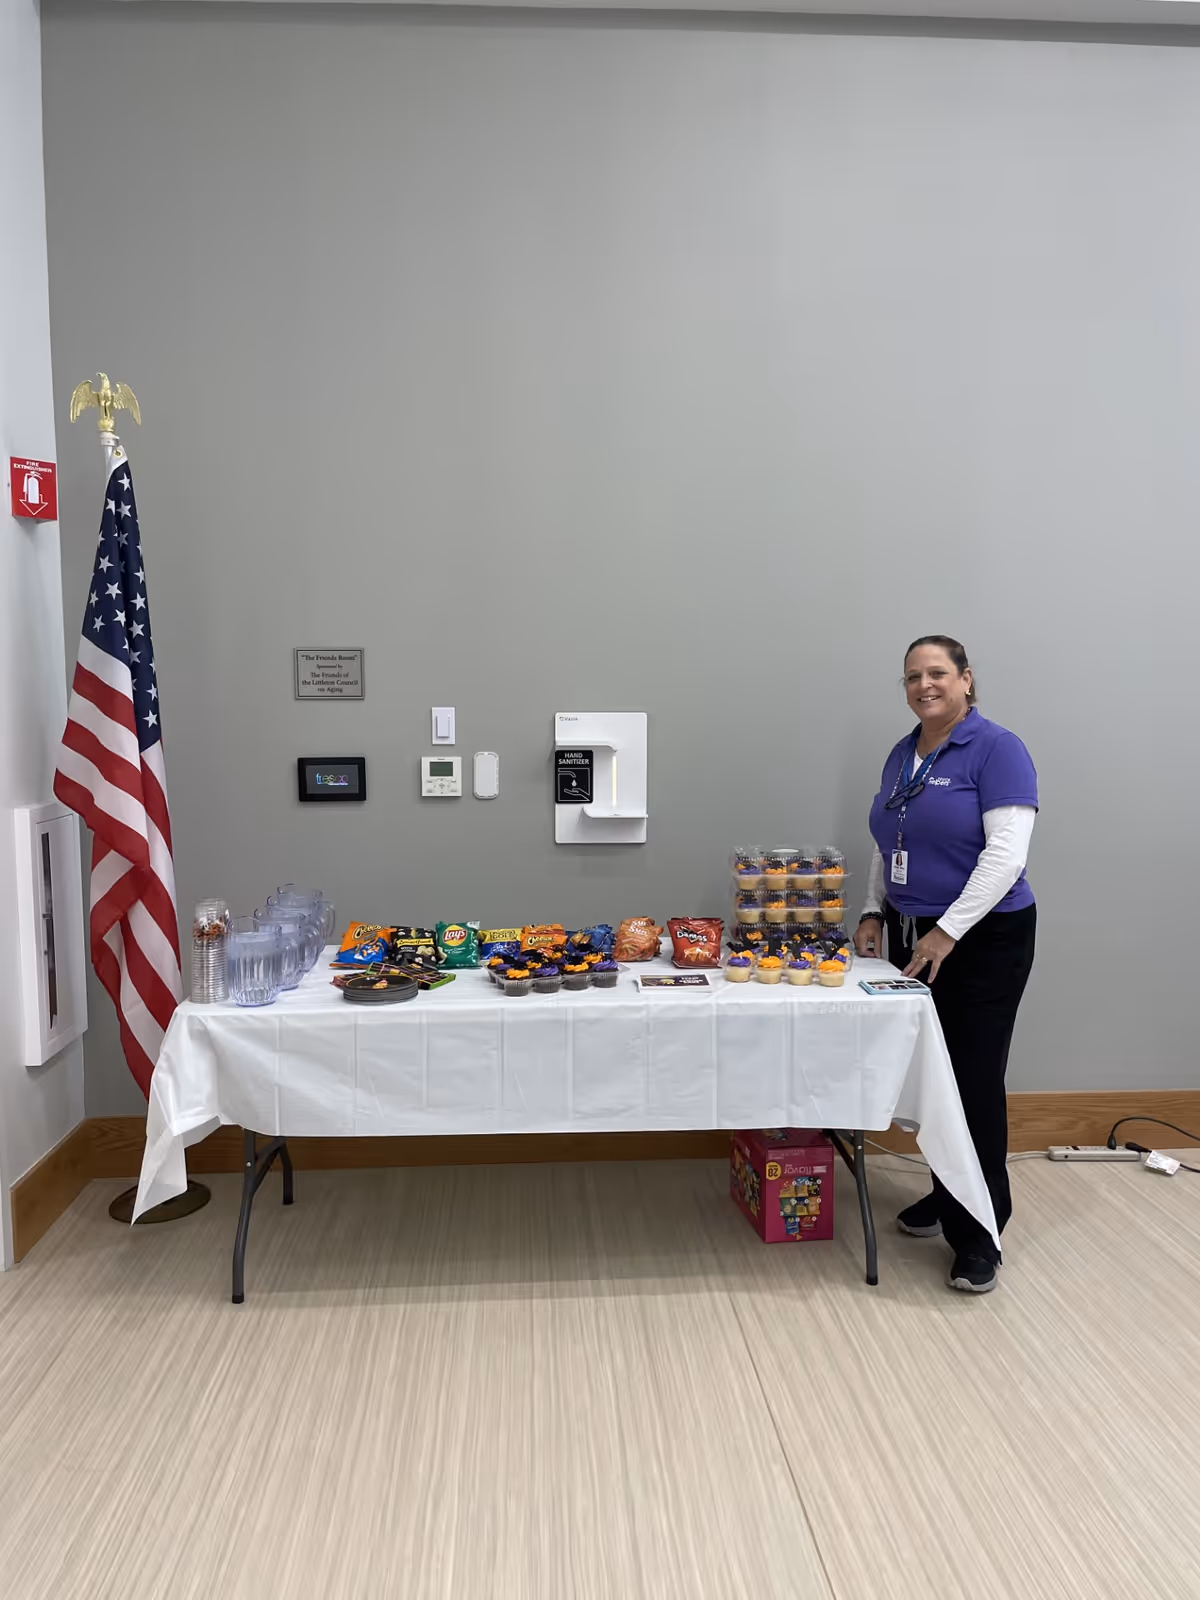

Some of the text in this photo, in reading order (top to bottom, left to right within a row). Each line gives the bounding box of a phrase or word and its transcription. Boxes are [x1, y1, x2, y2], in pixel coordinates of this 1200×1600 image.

[13, 463, 52, 473] EXTINGUISHER
[443, 929, 466, 940] Lay's
[628, 925, 648, 936] Sun
[768, 1168, 778, 1177] 28
[784, 1167, 811, 1175] flavor
